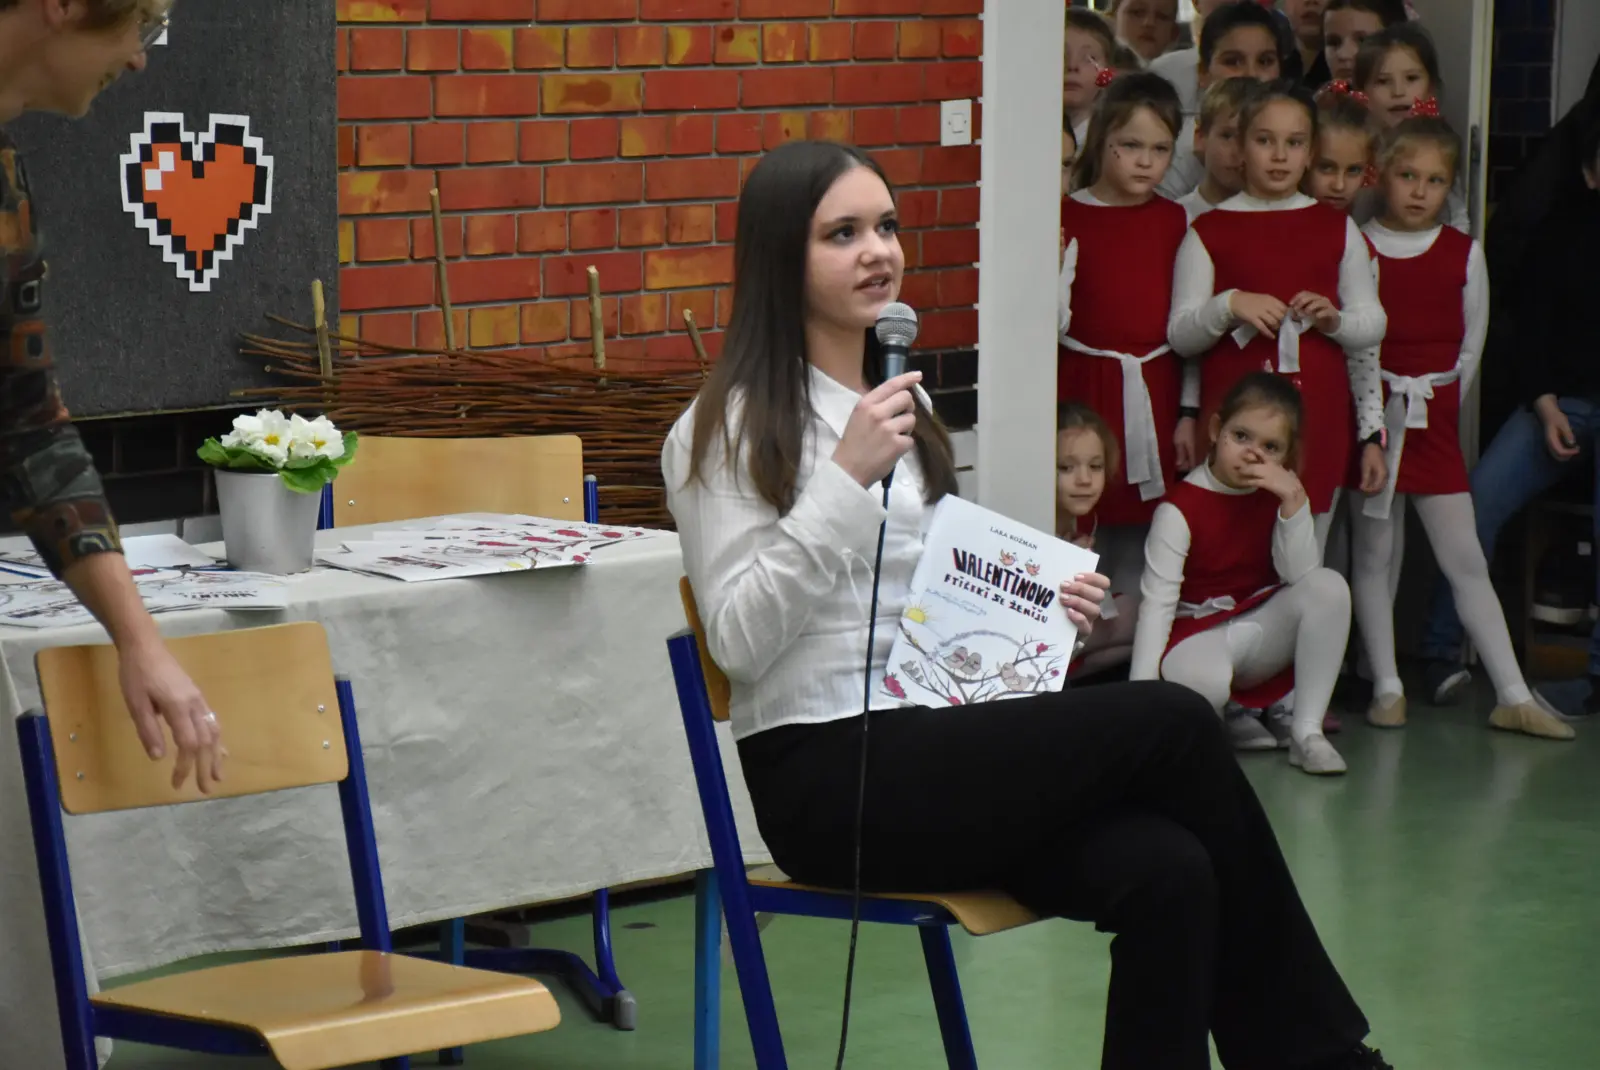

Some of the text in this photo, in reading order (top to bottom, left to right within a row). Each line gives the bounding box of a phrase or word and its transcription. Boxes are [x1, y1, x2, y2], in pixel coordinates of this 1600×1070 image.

[989, 526, 1038, 550] LARA ROŽMAN
[952, 547, 1056, 609] VALENTINOVO
[991, 593, 1006, 606] SE
